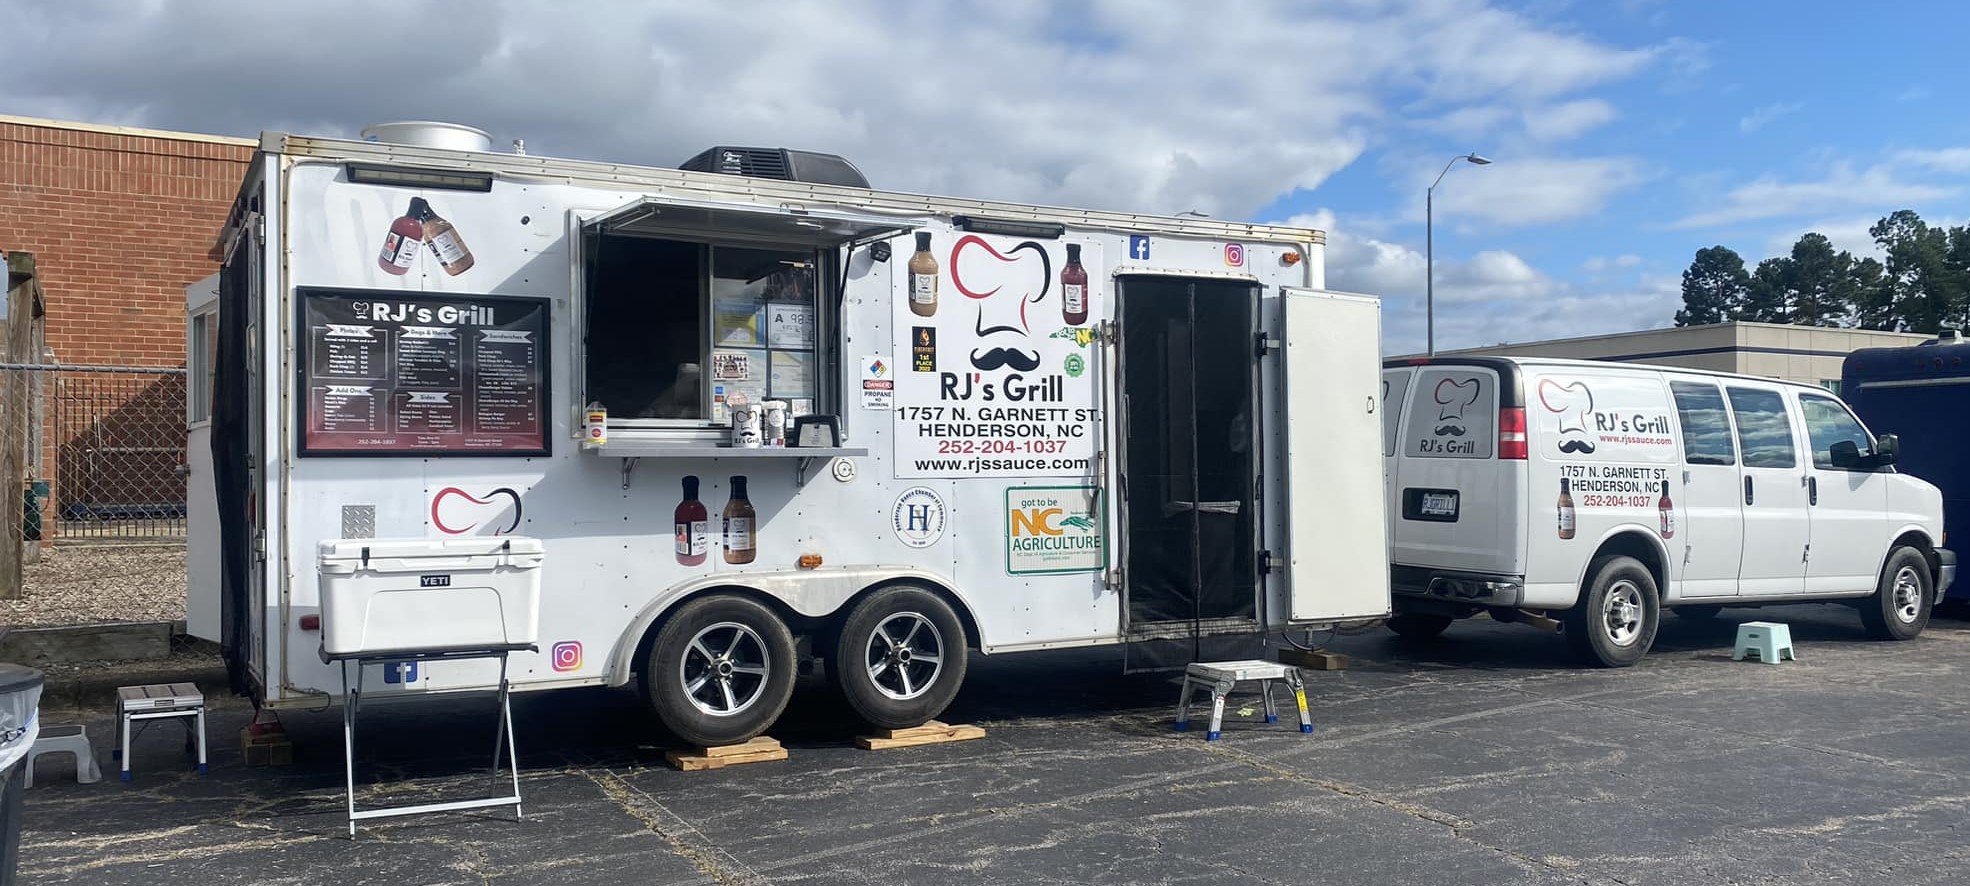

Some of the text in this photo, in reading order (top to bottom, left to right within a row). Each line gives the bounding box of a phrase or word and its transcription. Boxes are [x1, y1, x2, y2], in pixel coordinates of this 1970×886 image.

[372, 302, 494, 326] RJ's Grill
[775, 313, 784, 323] A
[489, 332, 523, 340] Sandwiches
[865, 381, 891, 389] DANGER
[941, 372, 1063, 402] RJ's Grill
[897, 406, 1102, 422] 1757 N. GARNETT ST.
[919, 423, 1084, 439] HENDERSON, NC
[1594, 412, 1670, 435] RJ's Grill
[938, 440, 1067, 454] 252-204-1037
[1420, 439, 1475, 454] RJ's Grill
[1599, 434, 1673, 446] www.rjssauce.com
[914, 456, 1089, 474] www.rjssauce.com
[1560, 465, 1670, 480] 1757 N. GARNETT ST.
[1571, 479, 1660, 494] HENDERSON, NC
[1021, 497, 1058, 509] got to be
[1583, 494, 1651, 508] 252-204-1037
[1011, 507, 1064, 537] NC
[1012, 535, 1101, 551] AGRICULTURE
[422, 576, 449, 586] YETI
